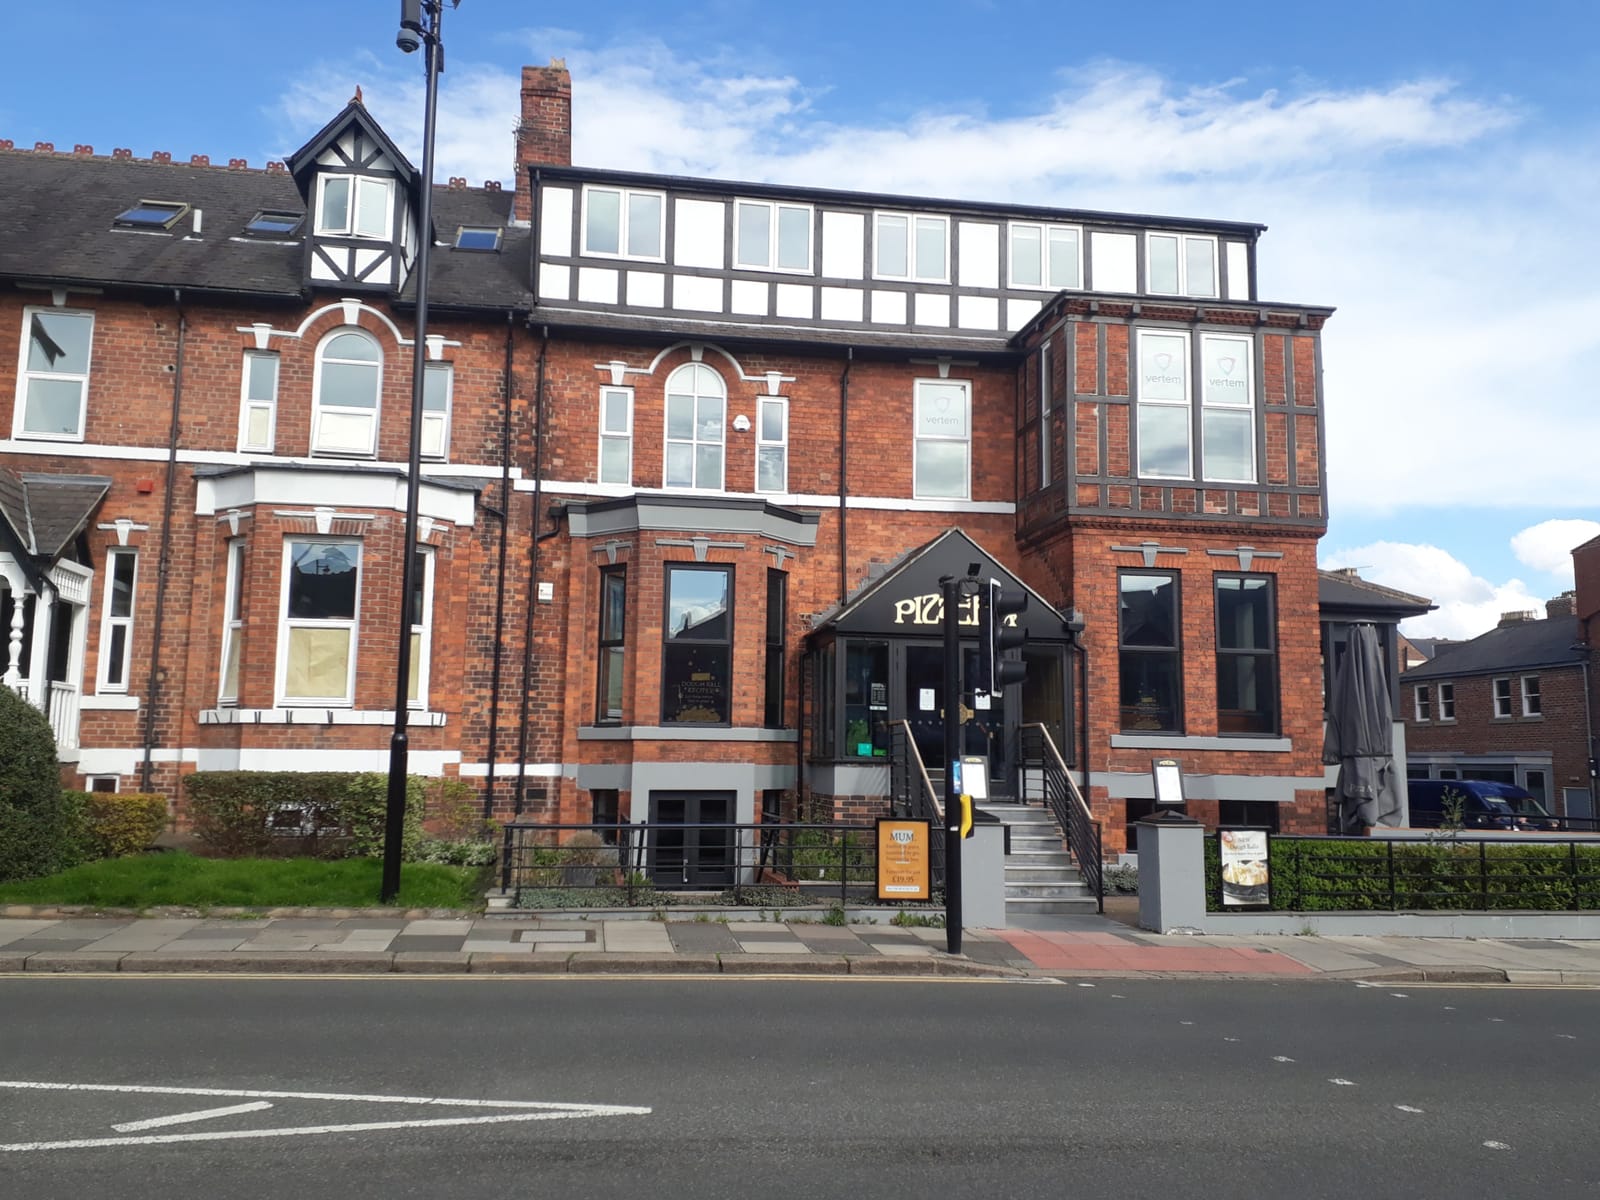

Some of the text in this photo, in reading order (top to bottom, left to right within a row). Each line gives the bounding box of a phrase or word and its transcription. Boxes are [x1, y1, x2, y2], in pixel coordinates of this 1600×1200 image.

[1144, 375, 1182, 385] vertem
[1208, 378, 1245, 388] vertem
[926, 416, 960, 425] vertem
[894, 594, 1017, 627] PIZE
